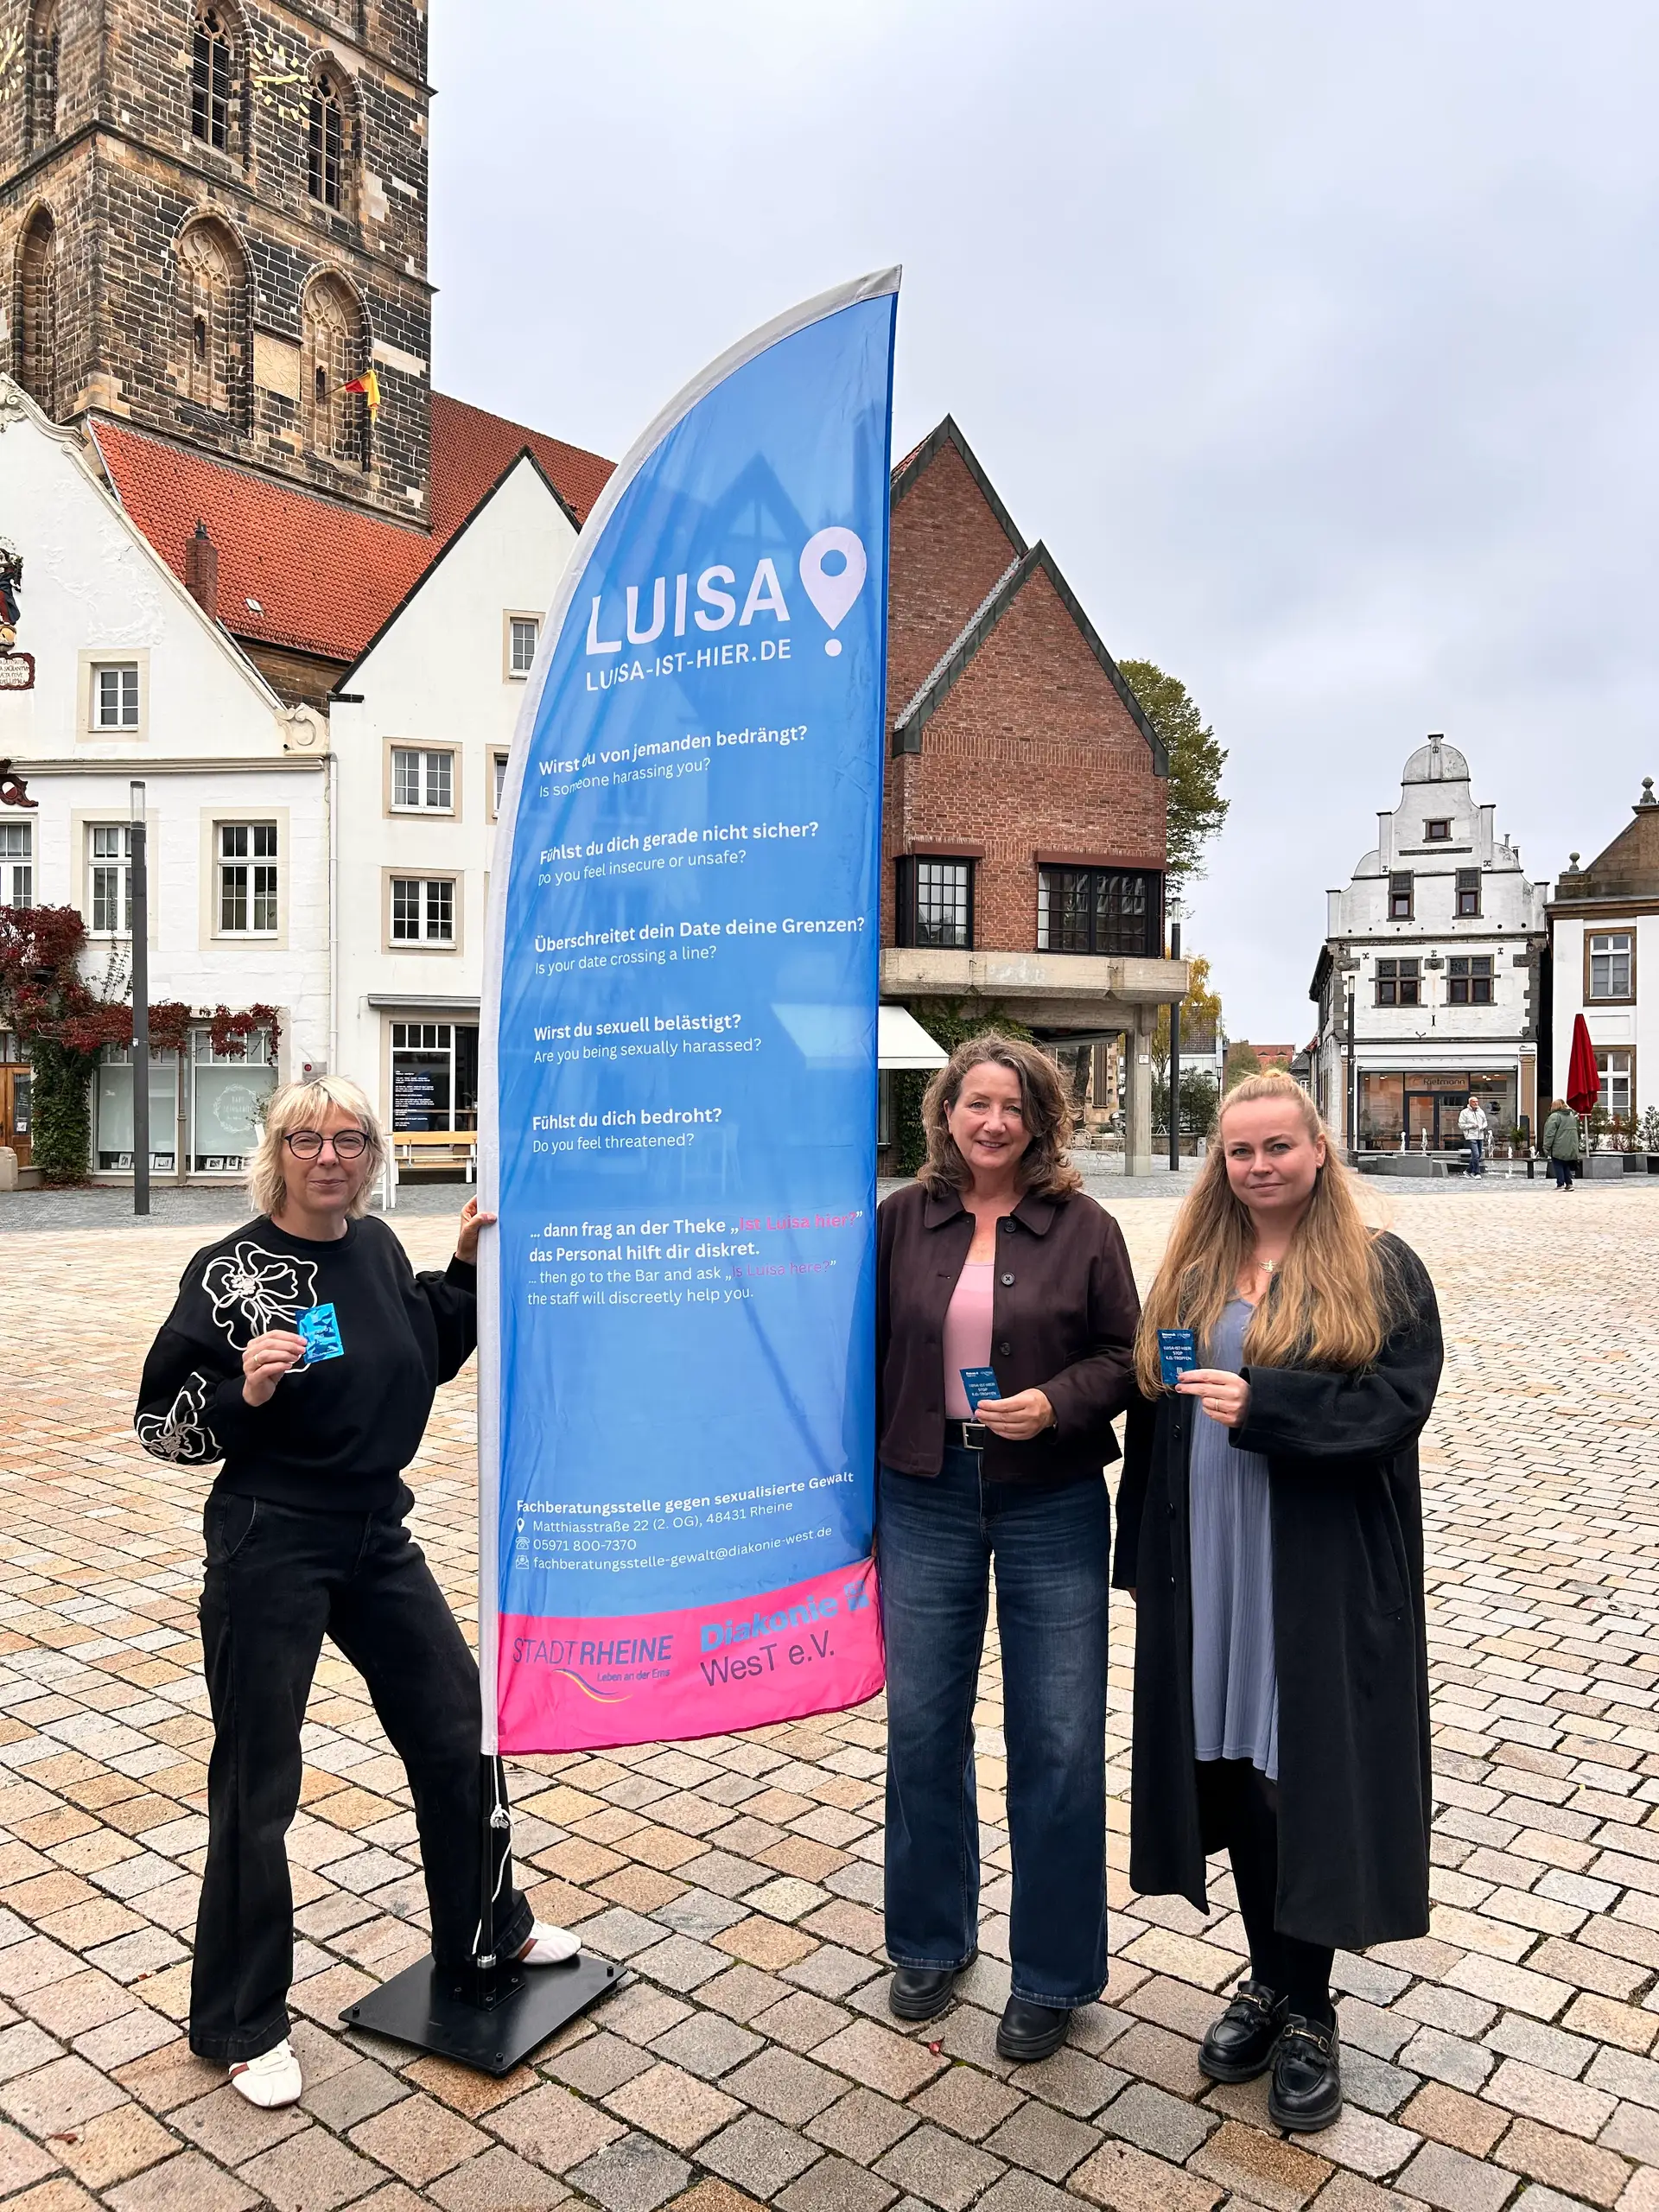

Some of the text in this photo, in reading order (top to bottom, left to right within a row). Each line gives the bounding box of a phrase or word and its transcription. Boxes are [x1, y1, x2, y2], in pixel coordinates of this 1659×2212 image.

[586, 557, 791, 656] LUISA
[586, 639, 791, 691] LUISA-IST-HIER.DE
[538, 725, 808, 776] Wirst du von jemanden bedrängt?
[539, 757, 711, 798] Is someone harassing you?
[540, 821, 819, 865] Fühlst du dich gerade nicht sicher?
[537, 849, 747, 887] Do you feel insecure or unsafe?
[534, 916, 865, 953] Überschreitet dein Date deine Grenzen?
[535, 945, 717, 977] Is your date crossing a line?
[533, 1014, 741, 1041] Wirst du sexuell belästigt?
[533, 1037, 762, 1065] Are you being sexually harassed?
[532, 1107, 722, 1131] Fühlst du dich bedroht?
[532, 1133, 695, 1155] Do you feel threatened?
[543, 1223, 578, 1237] dann
[582, 1221, 613, 1240] frag
[615, 1224, 636, 1236] an
[640, 1219, 670, 1236] der
[672, 1218, 726, 1234] Theke
[766, 1215, 810, 1230] Luisa
[529, 1242, 760, 1262] das Personal hilft dir diskret.
[539, 1270, 567, 1284] then
[569, 1272, 586, 1287] go
[588, 1270, 604, 1283] to
[607, 1269, 632, 1282] the
[635, 1268, 660, 1282] Bar
[664, 1267, 692, 1281] and
[696, 1265, 721, 1281] ask
[747, 1262, 785, 1277] Luisa
[527, 1287, 754, 1306] the staff will discreetly help you.
[517, 1471, 855, 1516] Fachberatungsstelle gegen sexualisierte Gewalt
[532, 1502, 793, 1533] Matthiasstraße 22 (2. OG), 48431 Rheine
[532, 1539, 637, 1552] 05971 800-7370
[533, 1526, 832, 1573] fachberatungsstelle-gewalt@diakonie-west.de
[700, 1595, 838, 1653] Diakonie
[700, 1630, 835, 1687] WesT e.V.
[596, 1672, 622, 1682] Leben
[636, 1670, 651, 1681] der
[652, 1669, 671, 1679] Ems
